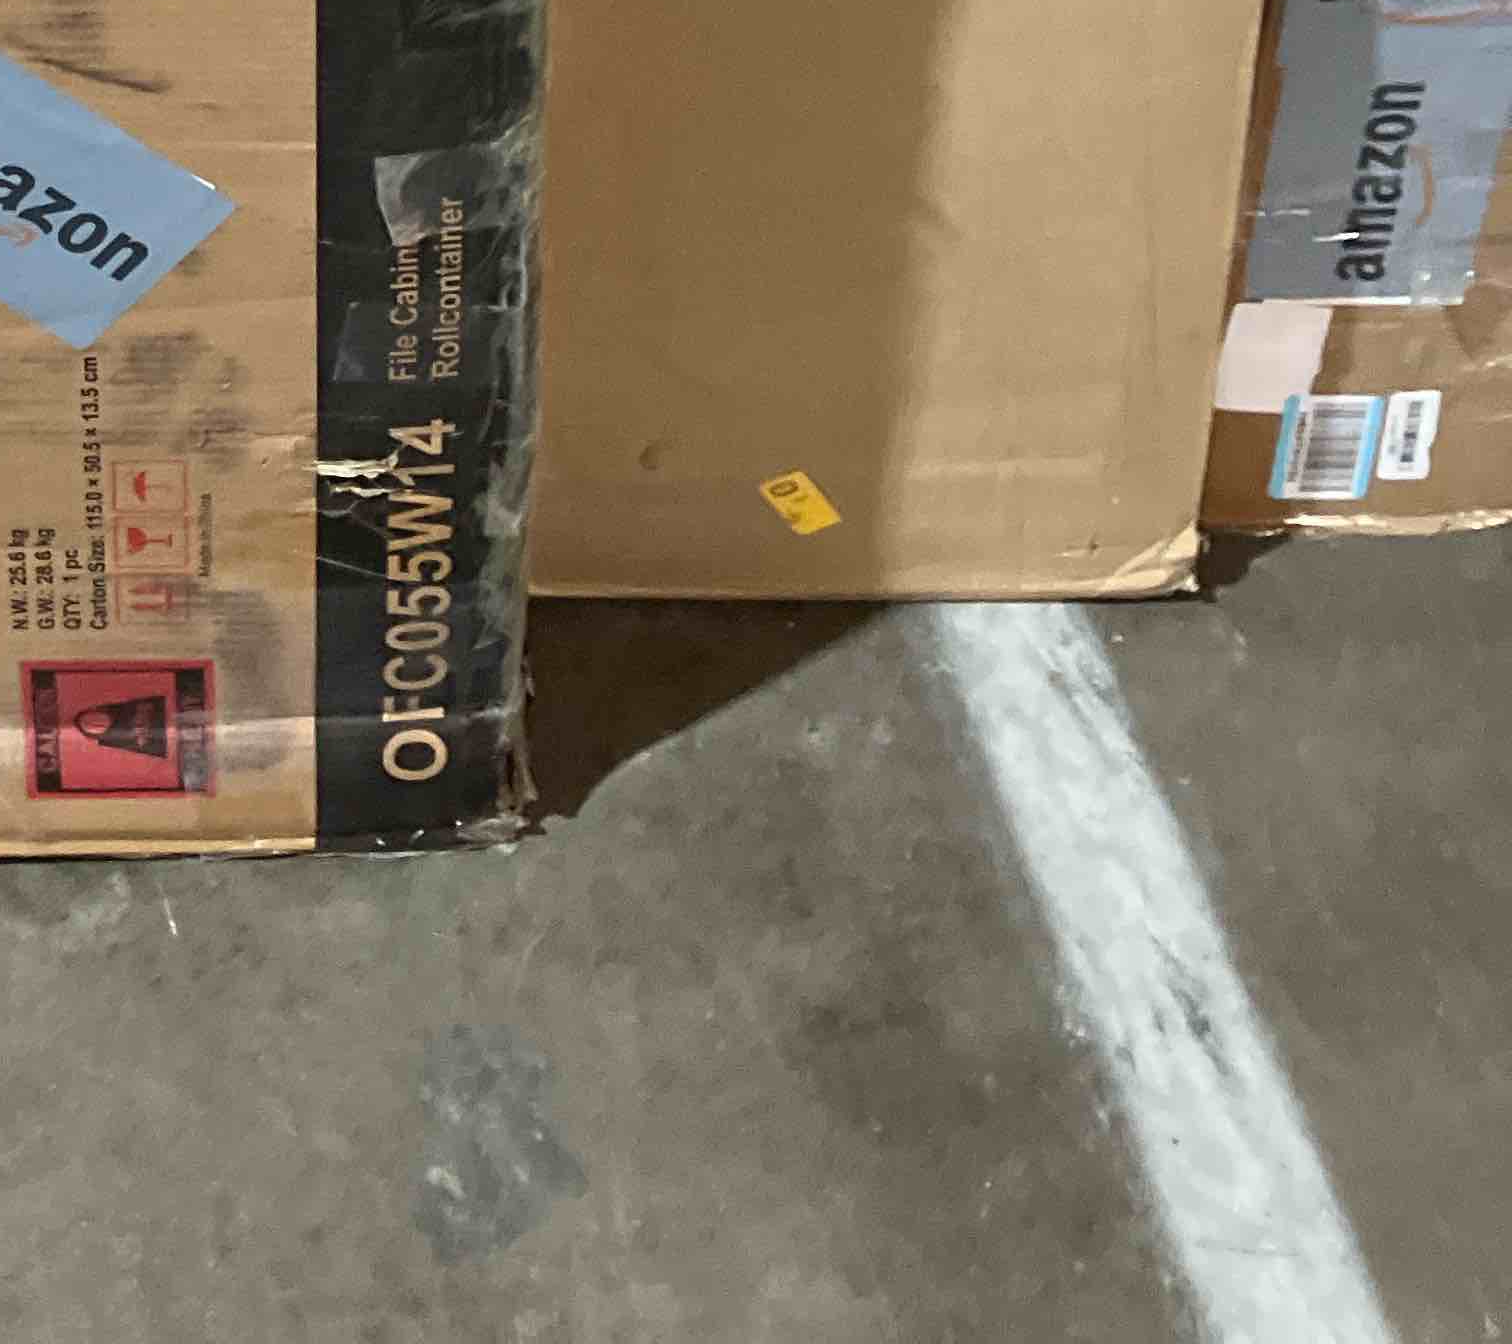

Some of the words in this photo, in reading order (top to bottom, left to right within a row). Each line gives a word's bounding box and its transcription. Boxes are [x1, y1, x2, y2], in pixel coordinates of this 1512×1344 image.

[1333, 80, 1427, 282] amazon
[389, 244, 419, 326] Cabin
[430, 195, 464, 379] Rollcontainer
[82, 355, 99, 383] cm
[388, 334, 418, 382] File
[81, 387, 100, 421] 13.5
[83, 442, 102, 474] 50.5
[84, 491, 104, 530] 115.0
[9, 528, 29, 548] kg
[35, 527, 56, 548] kg
[87, 535, 106, 573] Size:
[63, 549, 83, 570] pc
[63, 574, 80, 584] 1
[61, 593, 82, 630] QTY:
[89, 579, 108, 630] Carton
[381, 418, 456, 783] OFC055W14
